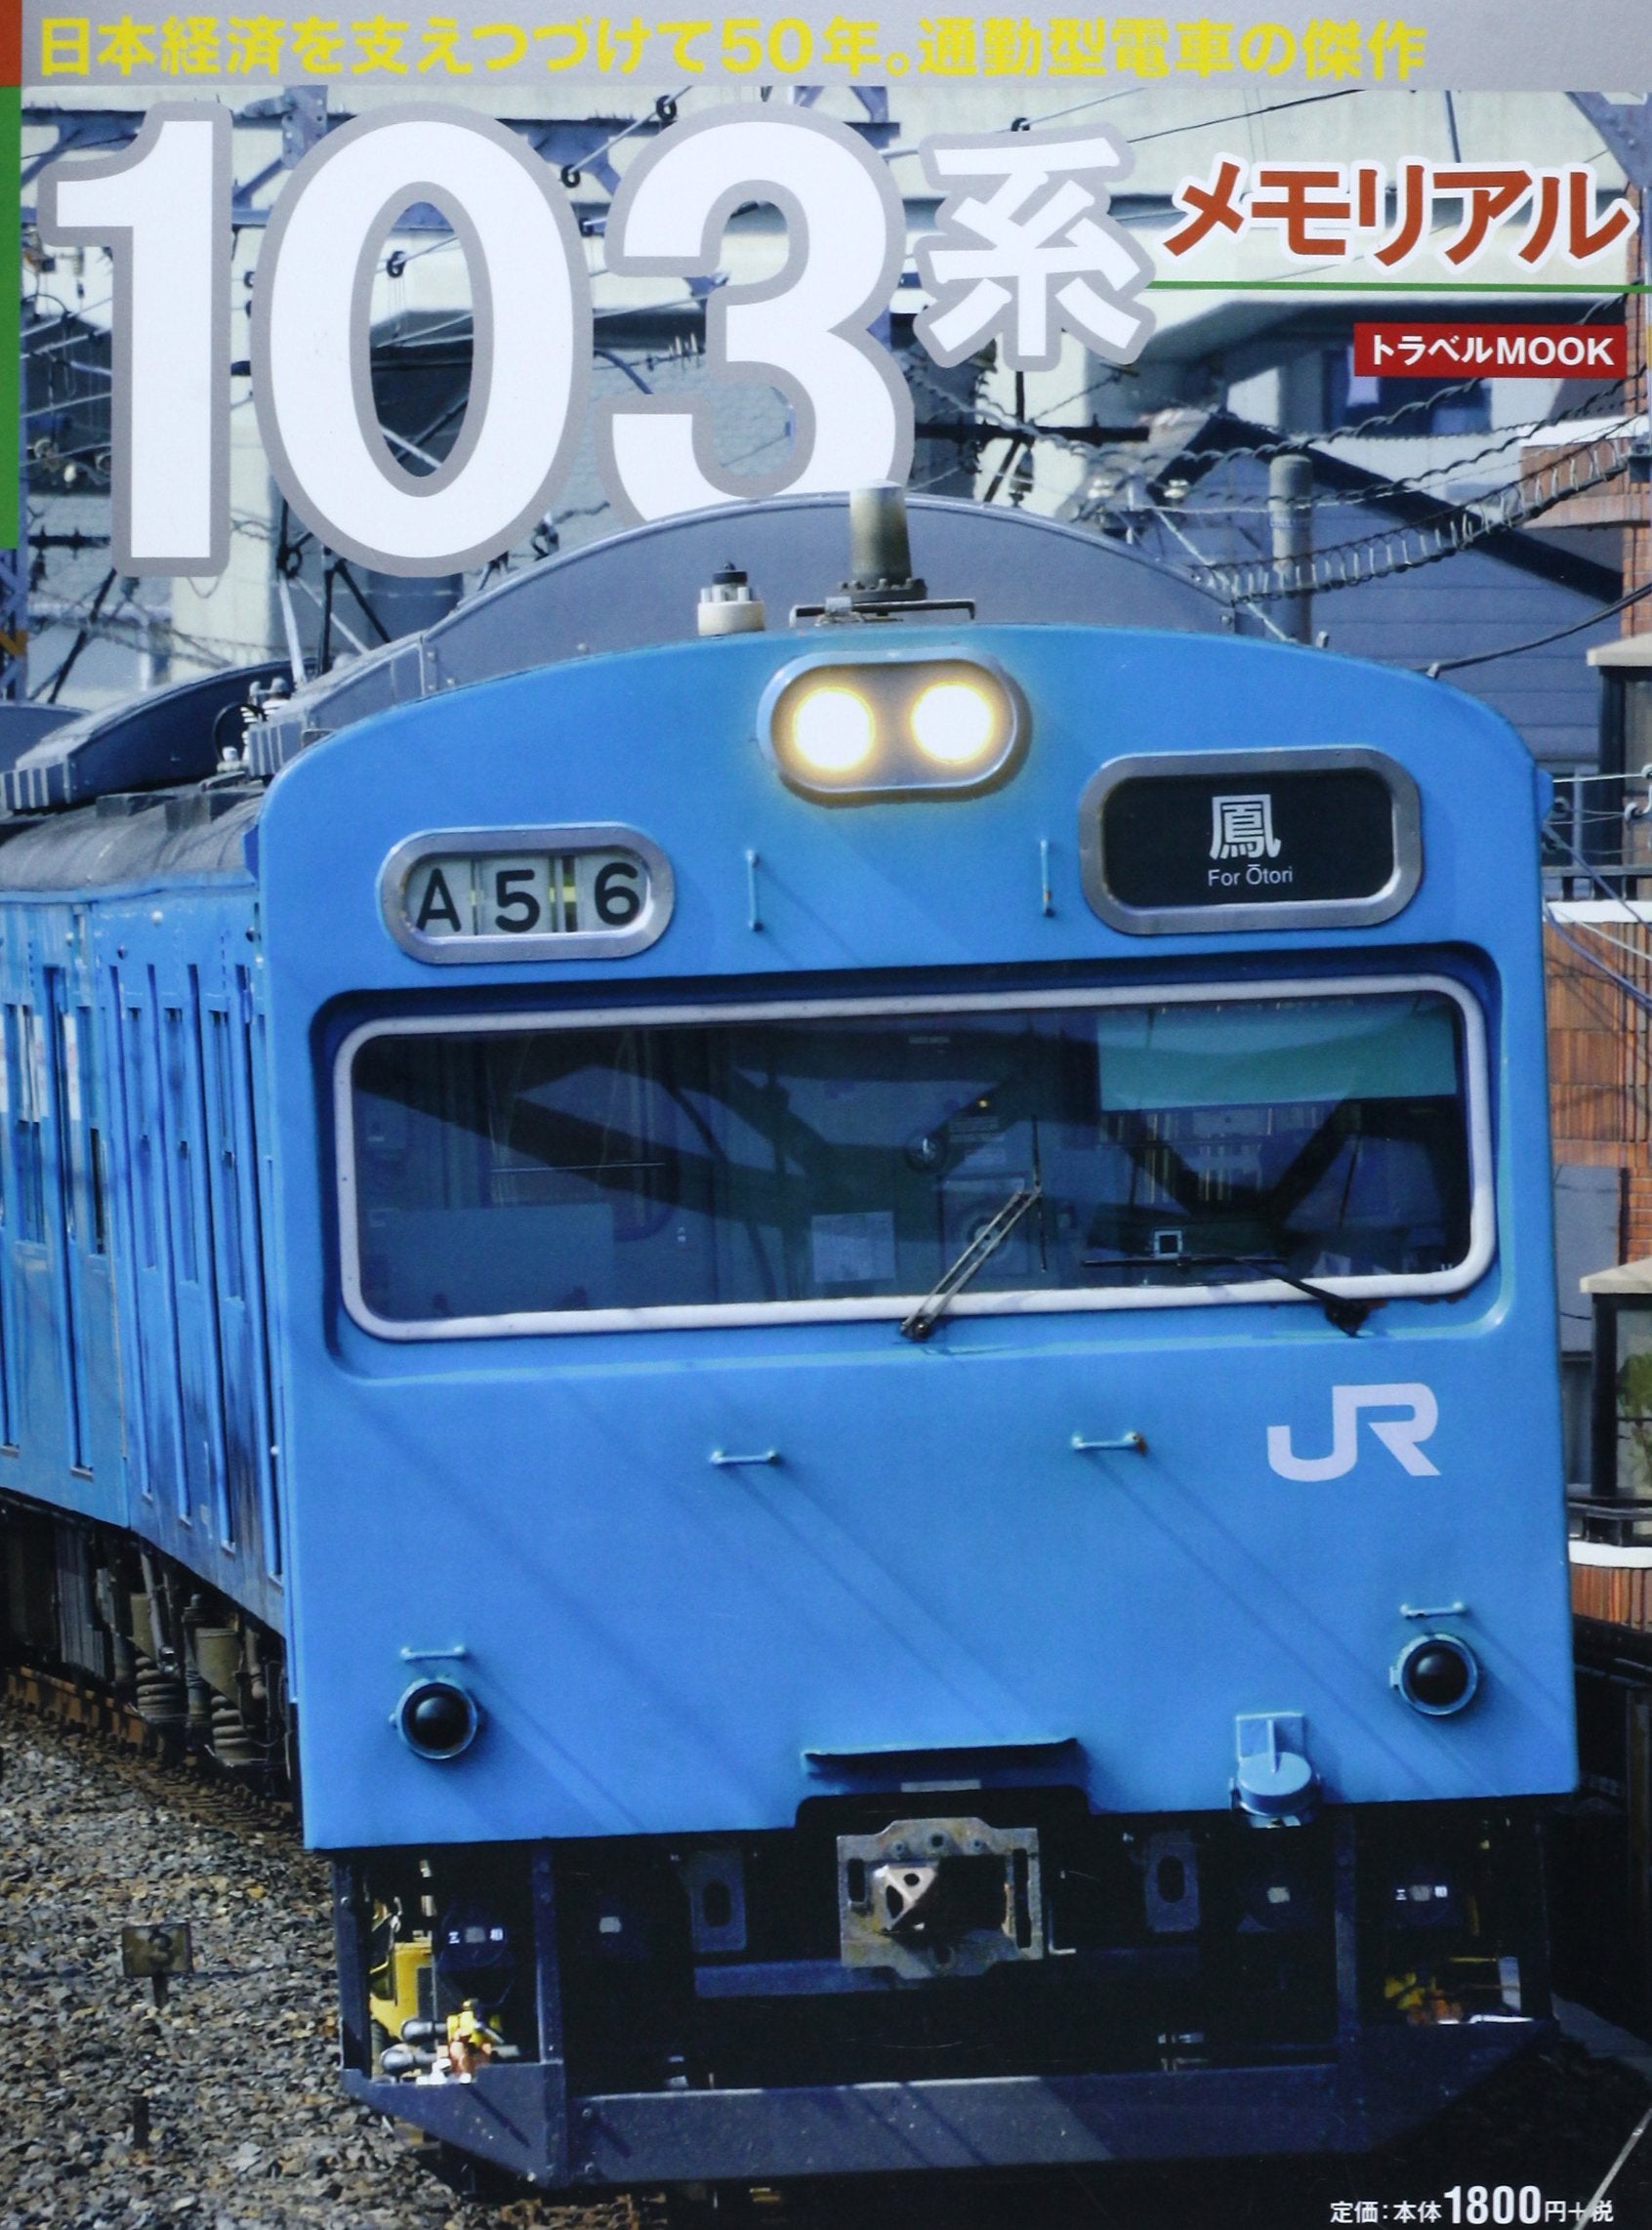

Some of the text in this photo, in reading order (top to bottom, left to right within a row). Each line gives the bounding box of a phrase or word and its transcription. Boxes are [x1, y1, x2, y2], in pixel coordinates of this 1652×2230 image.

[40, 14, 1427, 81] 日本経済を支えつづけて50年。通勤型電車の傑作
[1161, 160, 1632, 268] メモリアル
[1372, 334, 1615, 366] トラベルMOOK
[1209, 794, 1282, 860] 鳳
[1207, 869, 1240, 887] For
[1266, 1383, 1442, 1482] JR
